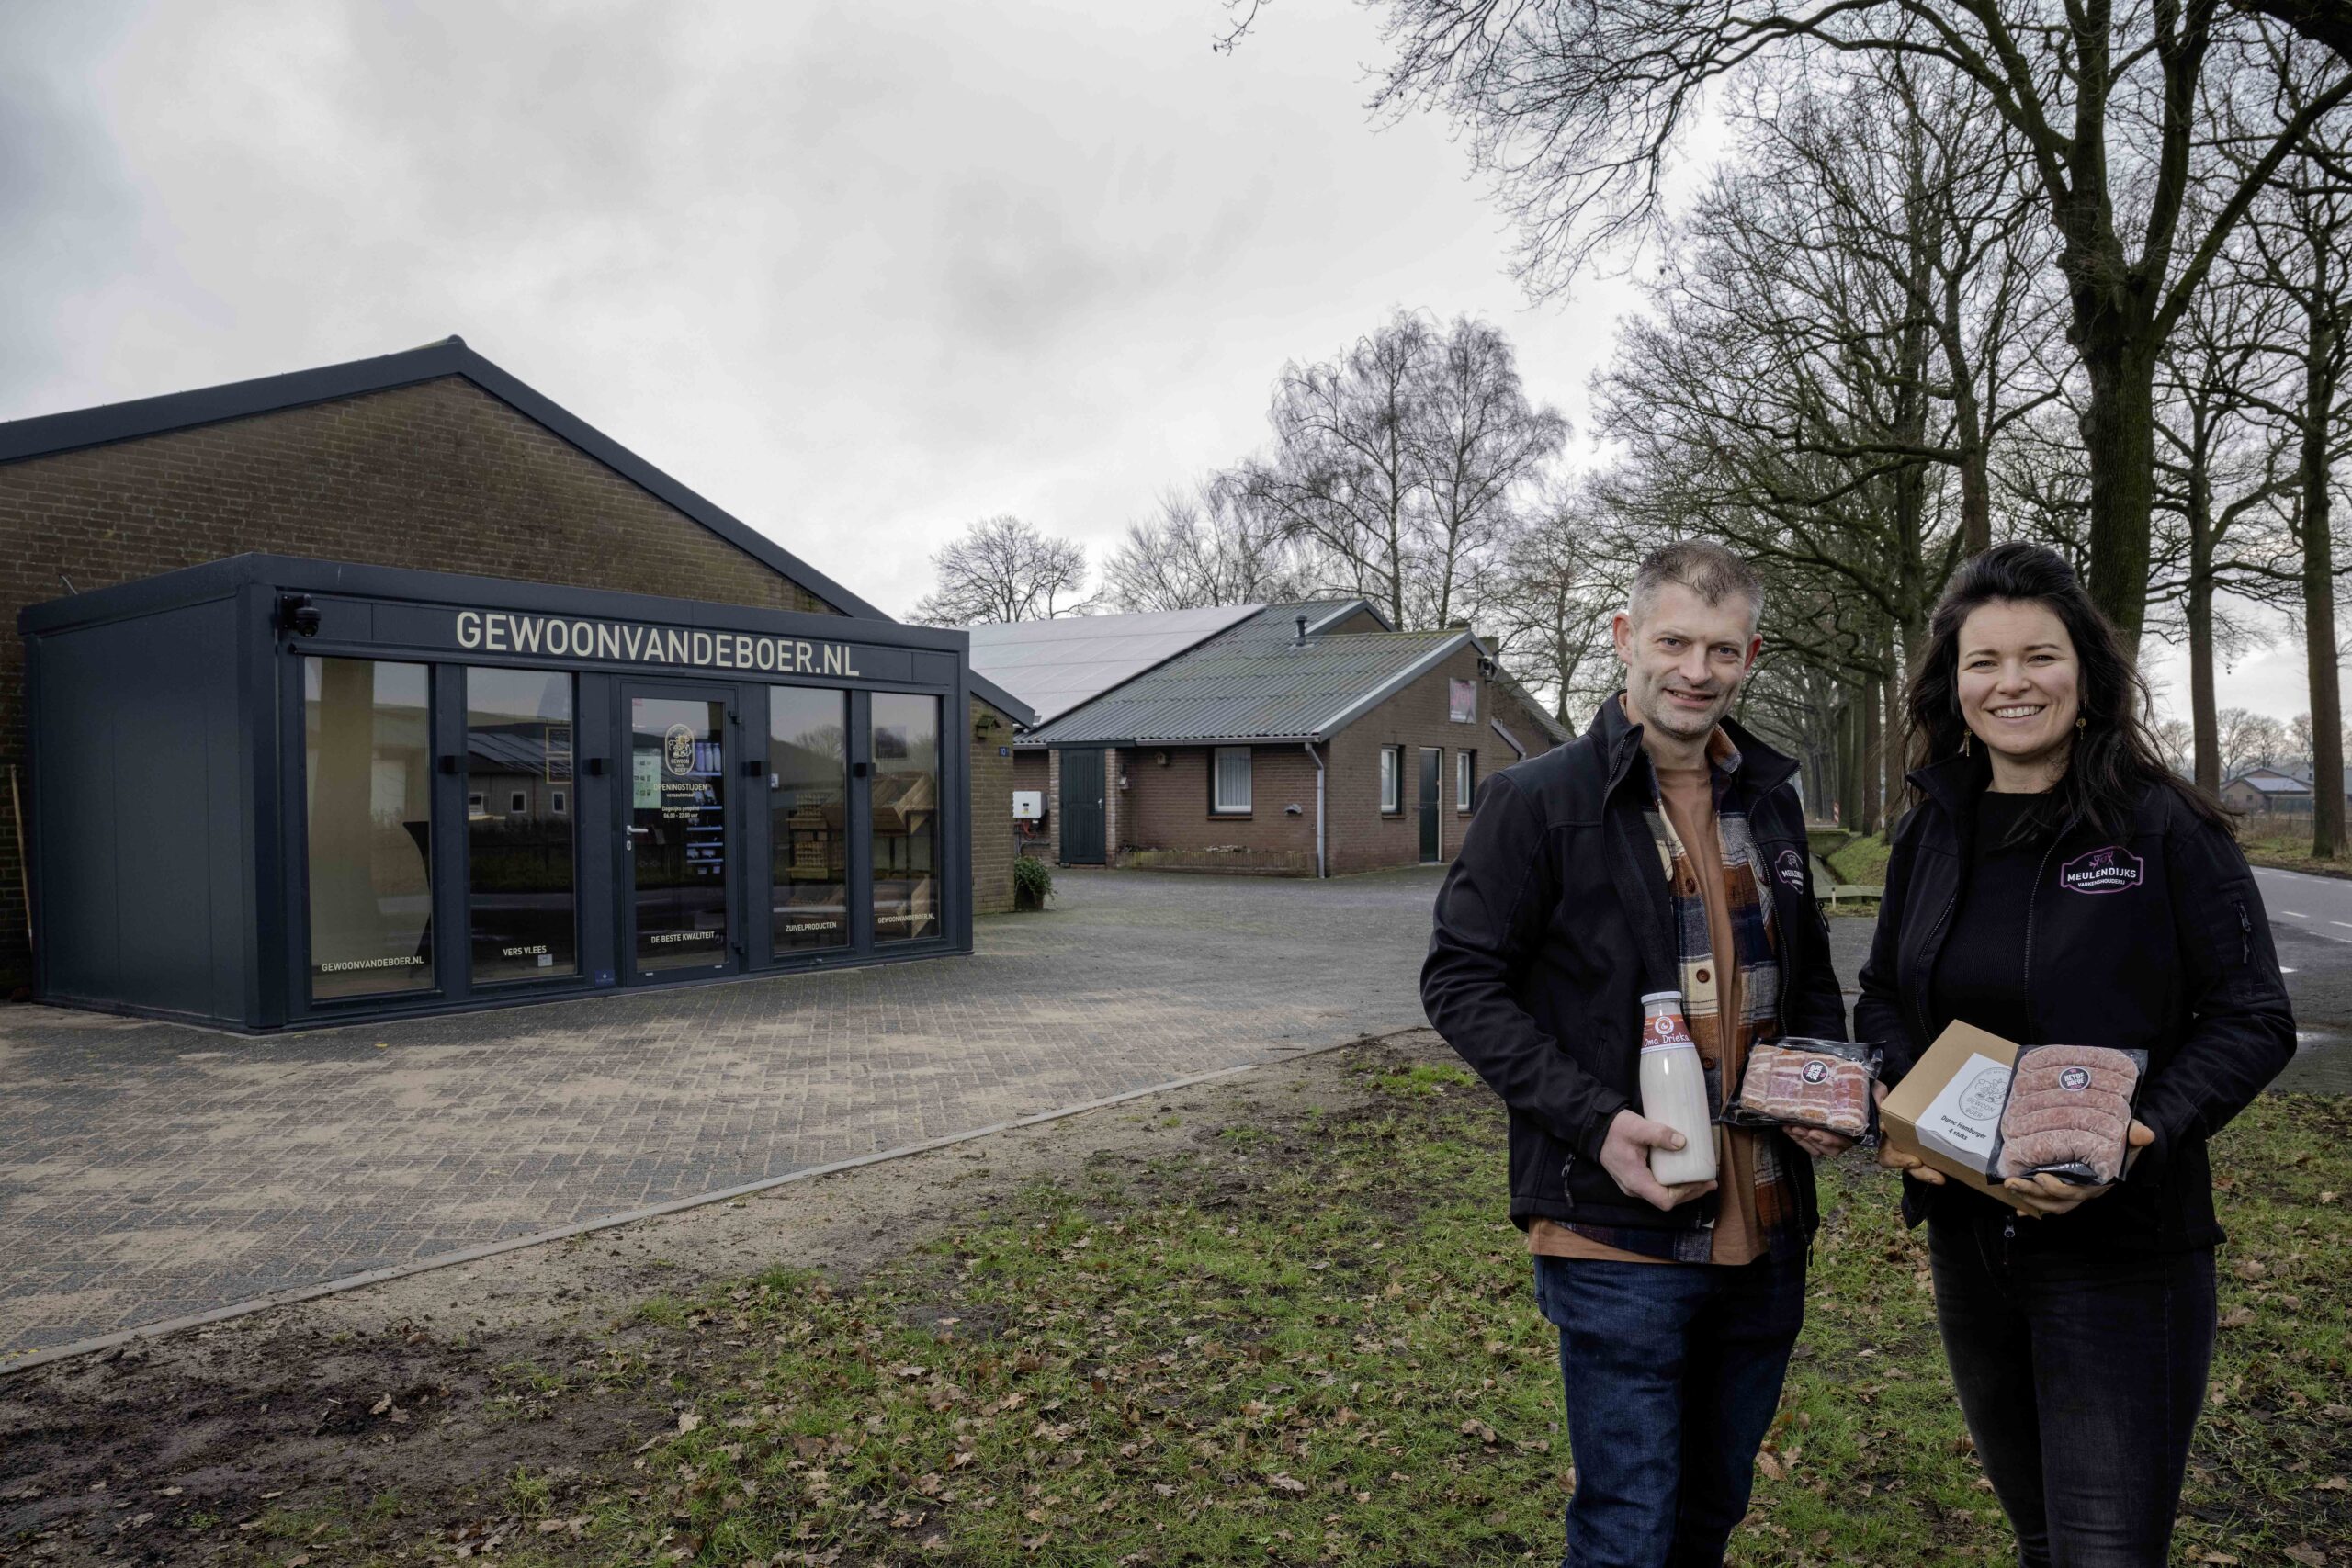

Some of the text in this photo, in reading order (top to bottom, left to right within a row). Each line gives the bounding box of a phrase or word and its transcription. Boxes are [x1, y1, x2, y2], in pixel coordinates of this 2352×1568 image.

[456, 611, 860, 676] GEWOONVANDEBOER.NL
[2067, 867, 2137, 882] MEULENDIJKS
[2077, 878, 2125, 887] VARKENSHOUDERIJ
[877, 913, 935, 924] GEWOONVANDEBOER.NL
[786, 921, 837, 932] ZUIVELPRODUCTEN
[650, 931, 715, 943] DE BESTE KWALITEIT
[503, 945, 547, 956] VERS VLEES
[322, 956, 424, 972] GEWOONVANDEBOER.NL
[1644, 1038, 1659, 1047] Oma
[2064, 1072, 2085, 1082] HEYDE
[1966, 1097, 1996, 1113] GEWOON
[1940, 1115, 1986, 1139] Duroc Hamburger
[1953, 1130, 1968, 1141] stuks
